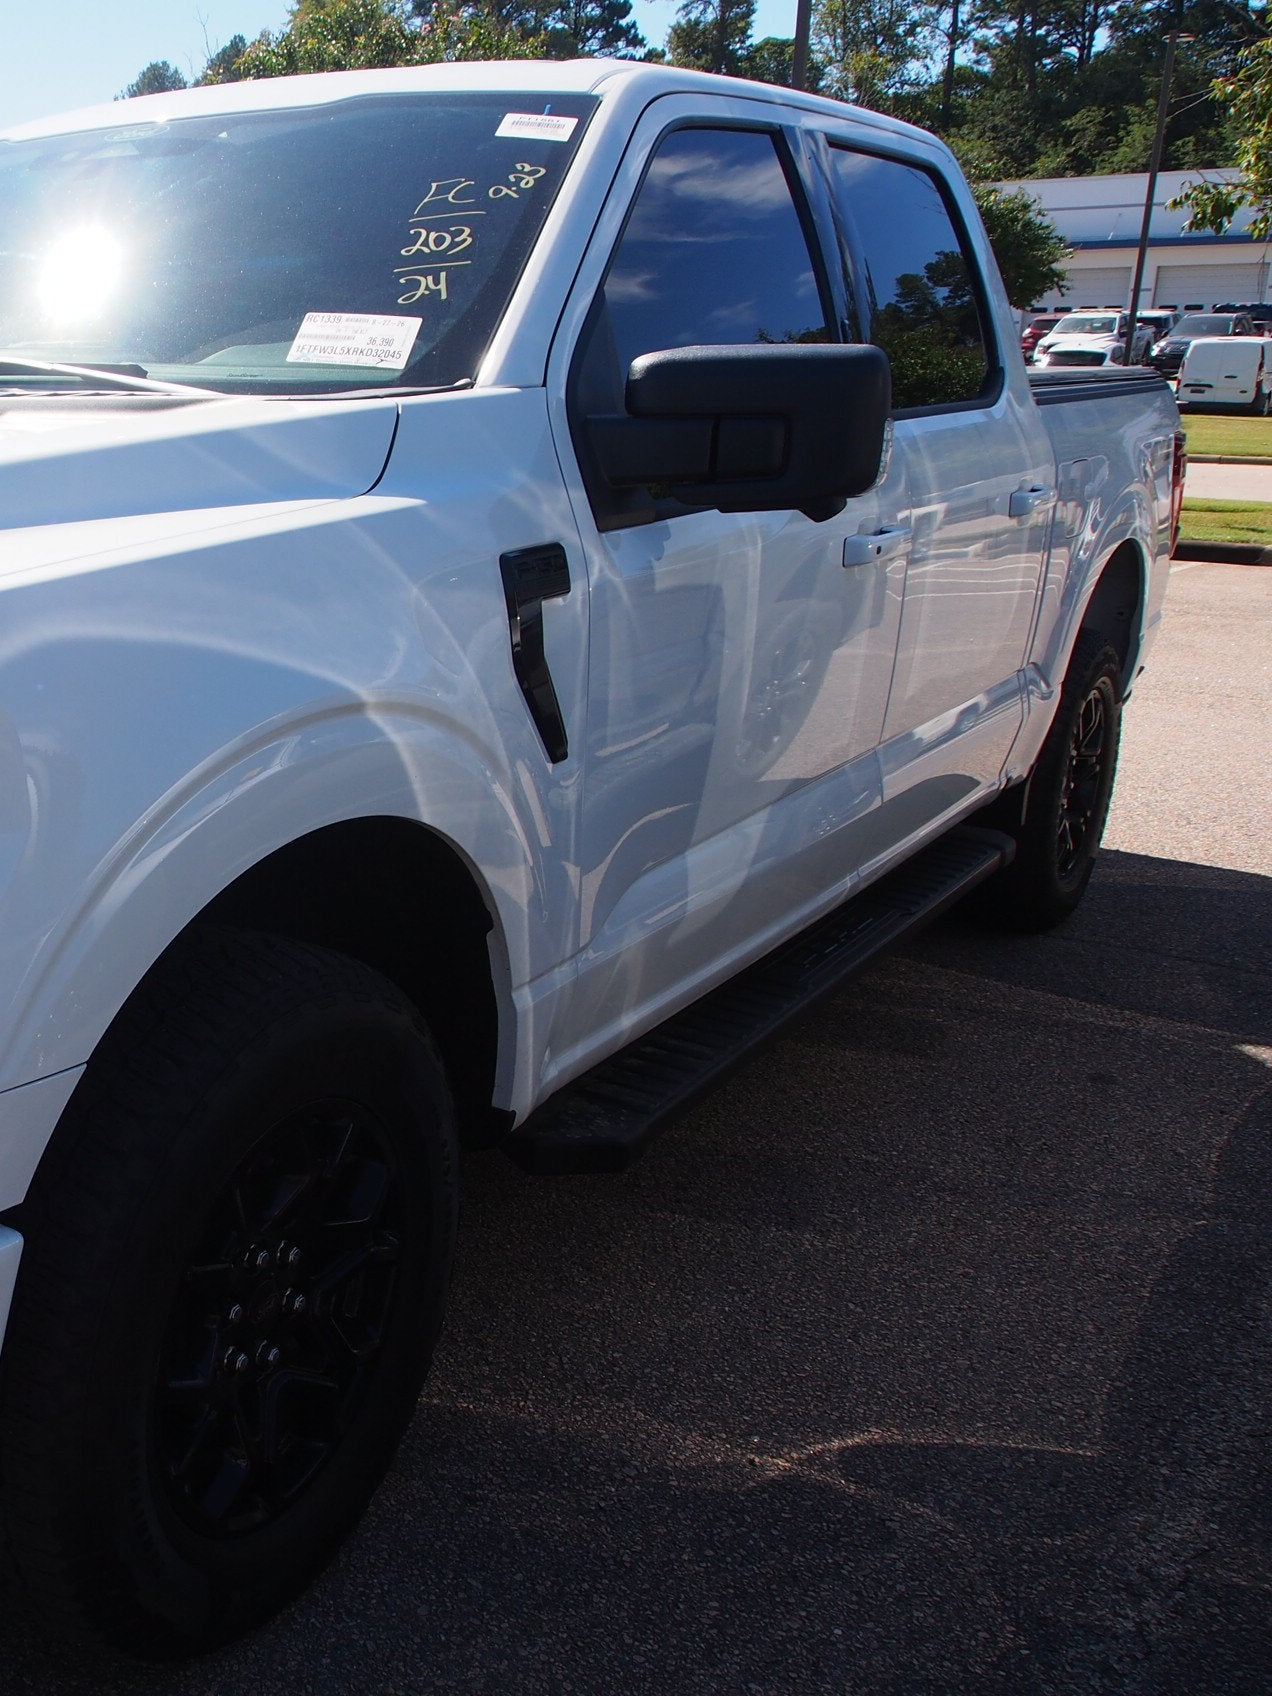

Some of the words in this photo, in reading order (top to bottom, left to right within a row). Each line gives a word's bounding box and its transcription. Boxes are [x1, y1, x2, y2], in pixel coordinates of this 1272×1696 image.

[400, 226, 473, 256] 203
[397, 271, 447, 304] 24
[305, 314, 343, 324] RC1339
[296, 345, 403, 360] 1FTFW3L5XRKD32045
